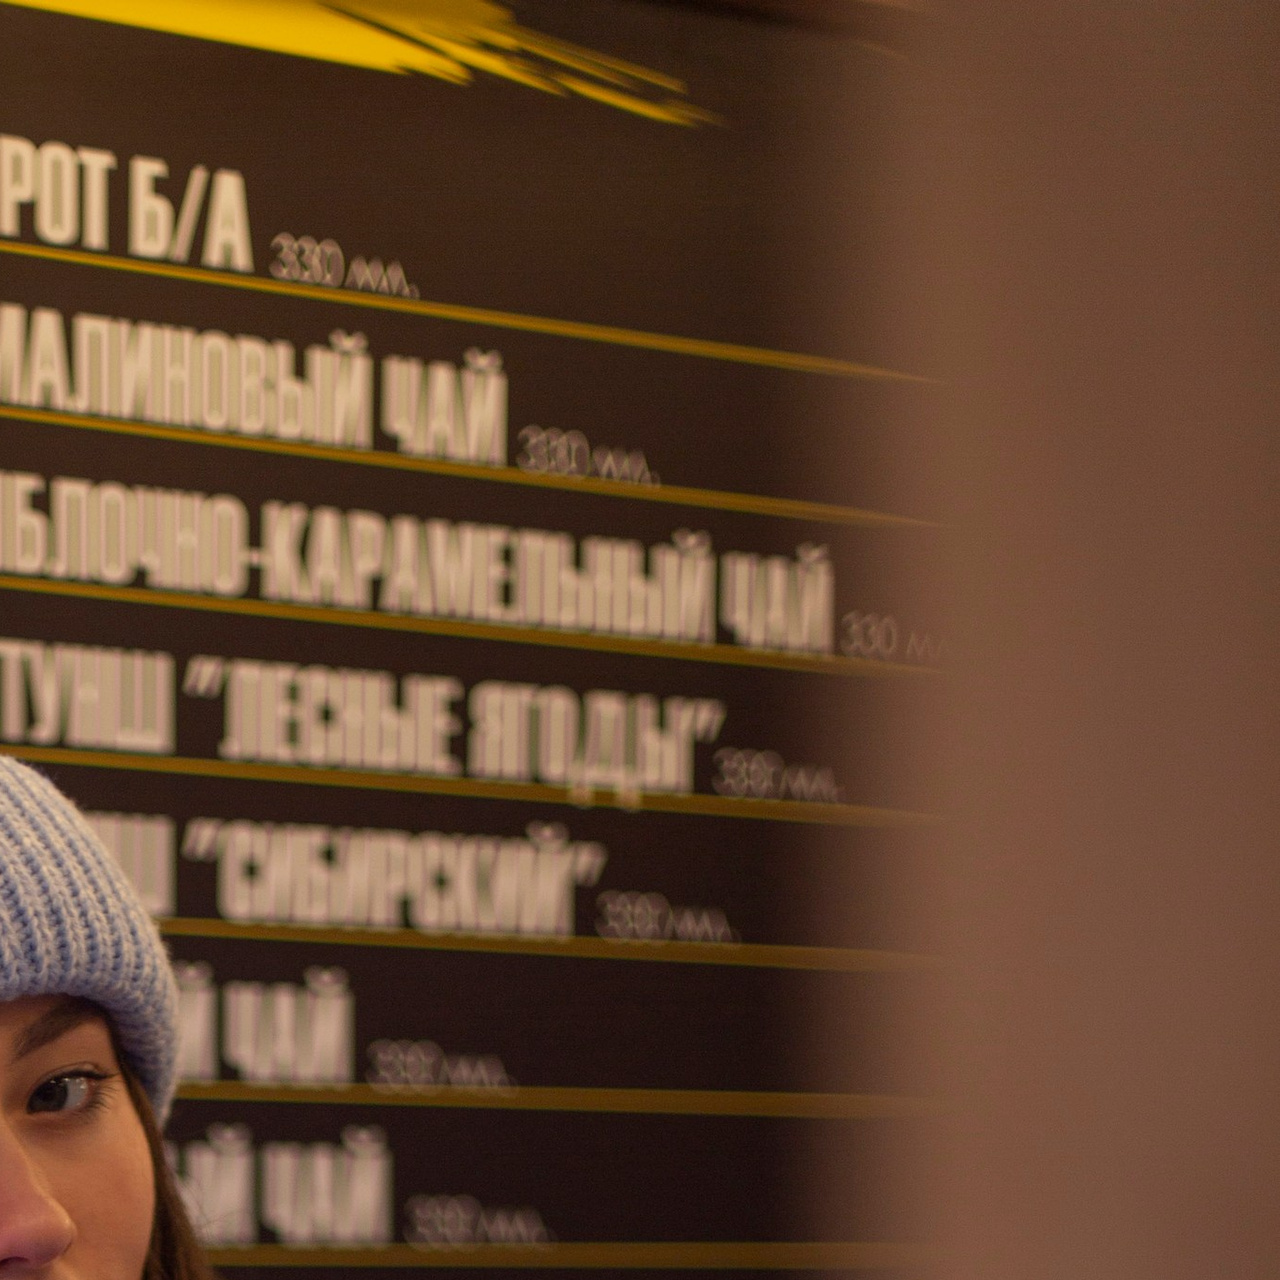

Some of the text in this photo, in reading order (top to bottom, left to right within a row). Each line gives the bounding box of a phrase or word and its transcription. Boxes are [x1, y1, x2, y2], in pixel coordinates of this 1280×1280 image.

[127, 154, 254, 274] Б/А
[269, 232, 345, 289] 330
[381, 345, 508, 468] ЧАЙ
[721, 541, 834, 655] ЧАЙ
[840, 610, 898, 658] 330
[223, 965, 356, 1088] ЧАЙ
[262, 1124, 395, 1248] ЧАЙ
